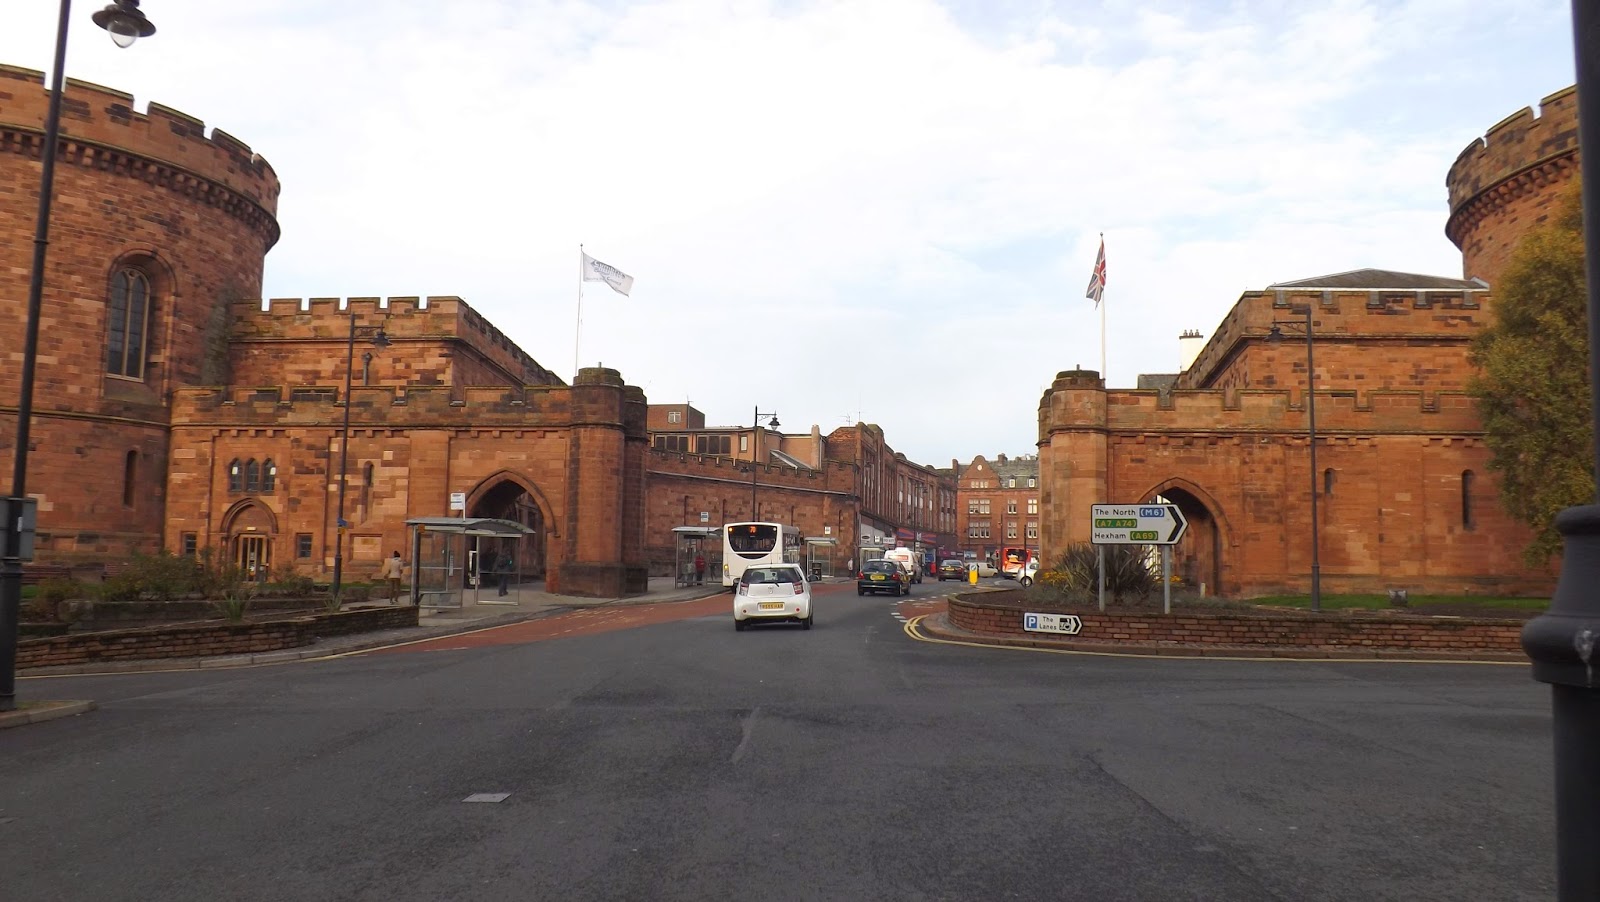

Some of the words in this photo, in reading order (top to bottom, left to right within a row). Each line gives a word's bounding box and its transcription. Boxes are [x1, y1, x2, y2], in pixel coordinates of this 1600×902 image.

[1094, 508, 1109, 516] The
[1112, 508, 1136, 516] North
[1028, 616, 1037, 628] P
